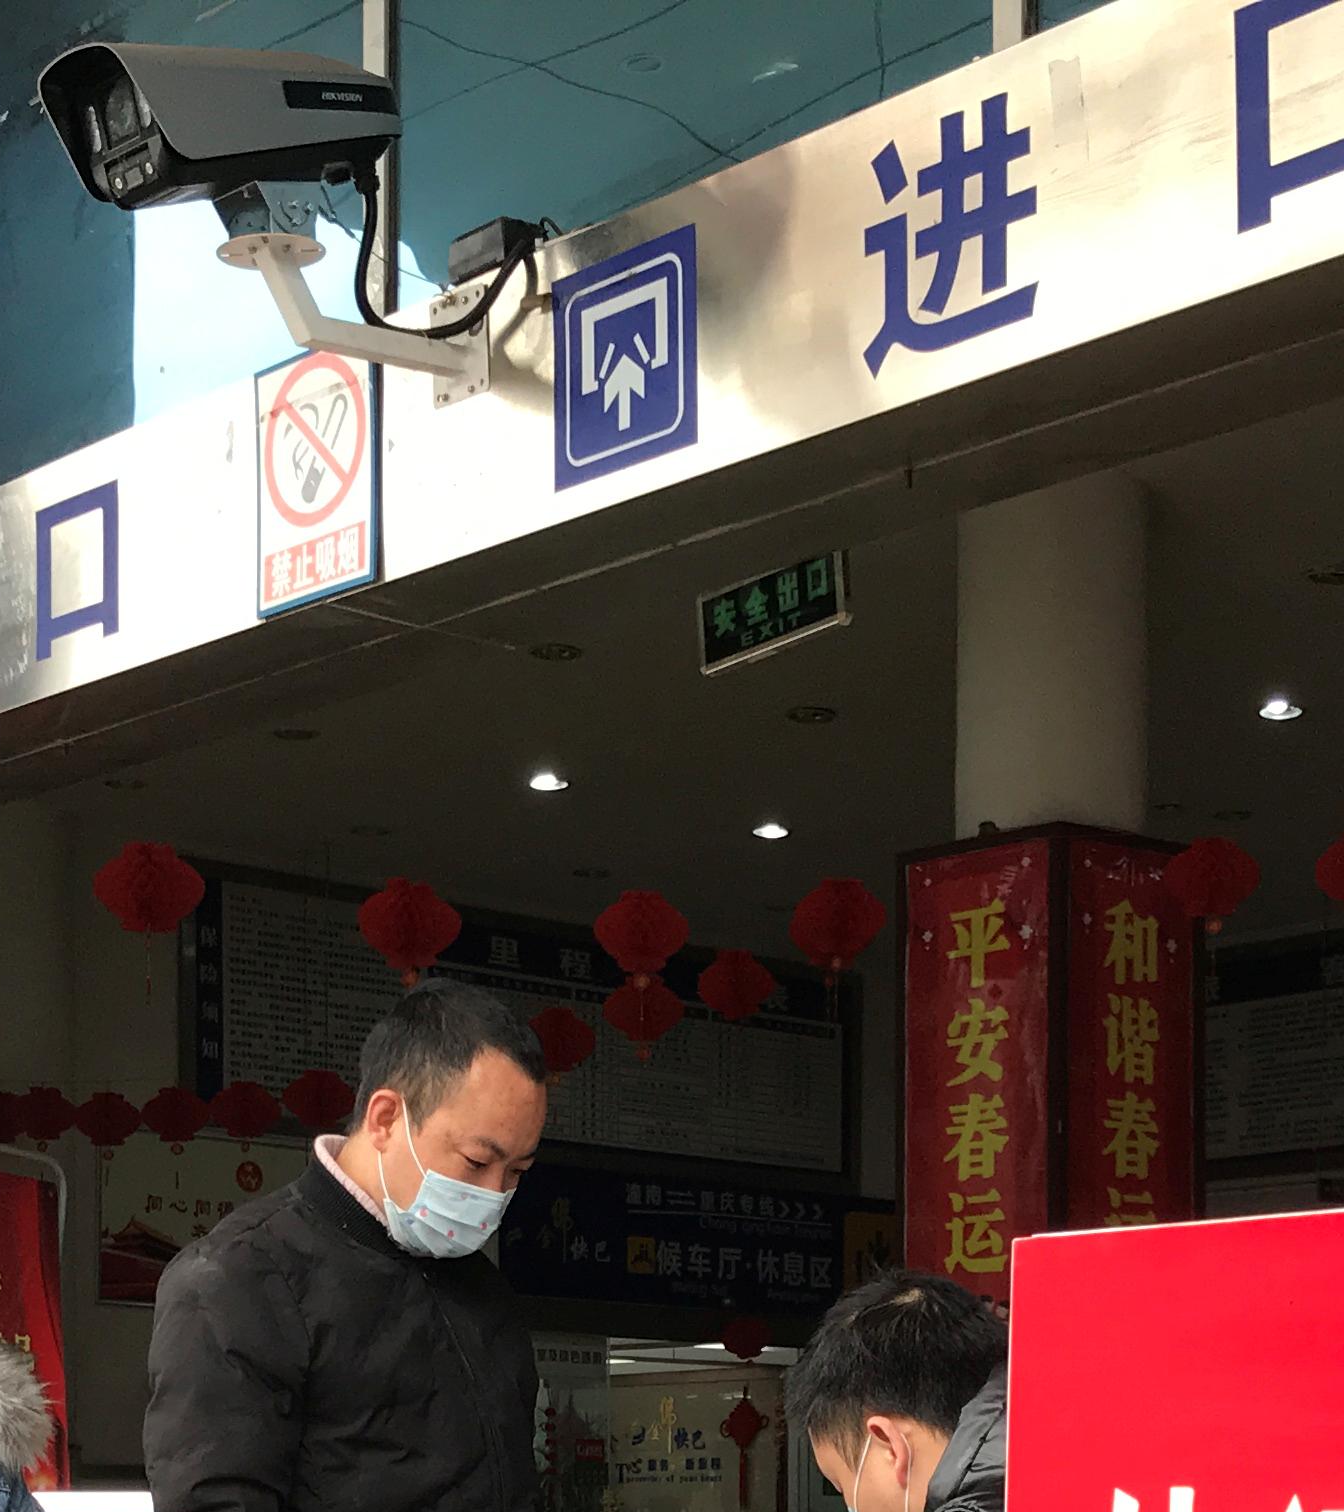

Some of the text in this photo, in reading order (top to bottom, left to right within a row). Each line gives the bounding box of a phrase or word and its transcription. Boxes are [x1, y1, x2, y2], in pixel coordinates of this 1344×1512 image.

[321, 92, 363, 102] HIKVISION
[271, 526, 360, 598] 禁止吸烟
[712, 558, 828, 639] 安全出口
[740, 611, 801, 646] EXIT
[943, 898, 1011, 1274] 平安春运
